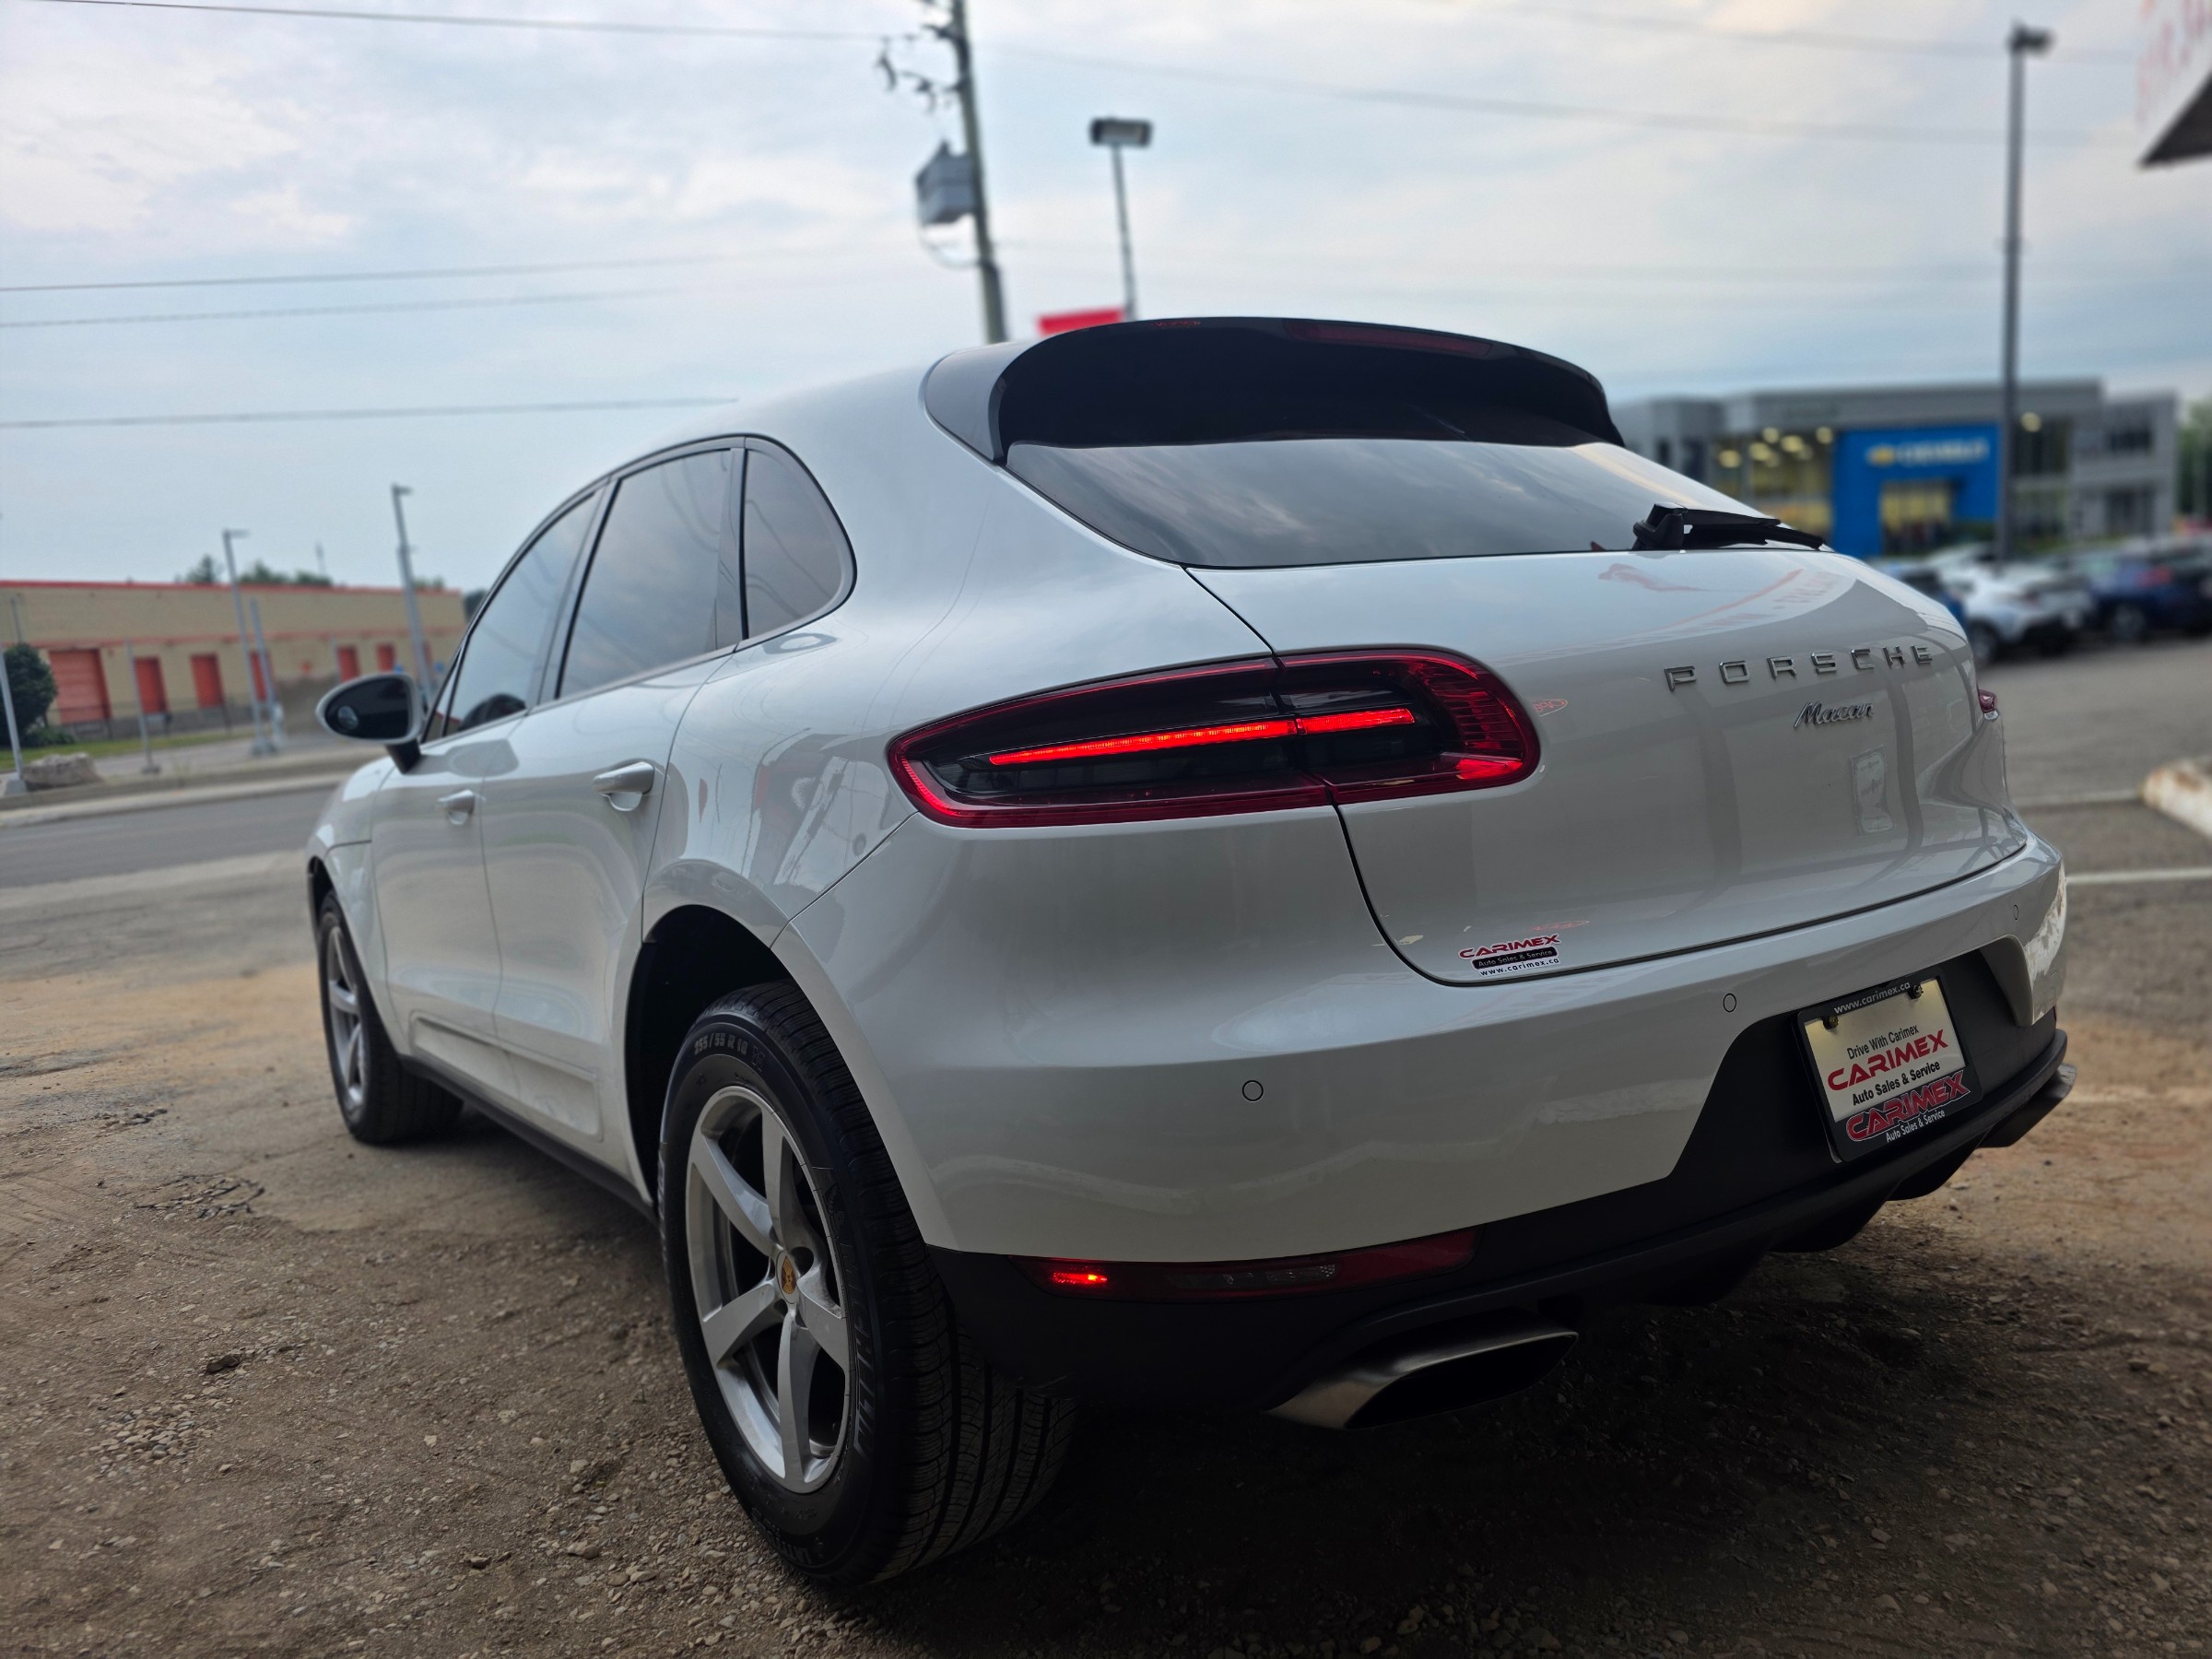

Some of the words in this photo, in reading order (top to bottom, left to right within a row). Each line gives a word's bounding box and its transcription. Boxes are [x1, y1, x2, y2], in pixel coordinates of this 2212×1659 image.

[1664, 644, 1934, 692] PORSCHE
[1793, 700, 1874, 729] Macan
[1459, 934, 1560, 959] CARIMEX
[1478, 959, 1497, 969] Auto
[1497, 956, 1518, 965] Sales
[1527, 949, 1553, 959] Service
[1480, 958, 1559, 976] www.carimex.ca
[1834, 982, 1911, 1014] www.carimex.ca
[1846, 1045, 1870, 1060] Drive
[1869, 1037, 1888, 1052] With
[1888, 1024, 1920, 1043] Carimex
[1828, 1029, 1949, 1091] CARIMEX
[1853, 1089, 1875, 1106] Auto
[1875, 1078, 1900, 1096] Sales
[1900, 1073, 1910, 1085] &
[1911, 1061, 1941, 1081] Service
[1847, 1071, 1970, 1141] CARIMEX
[1886, 1130, 1901, 1144] Auto
[1900, 1122, 1918, 1135] Sales
[1917, 1117, 1924, 1128] &
[1924, 1109, 1946, 1125] Service
